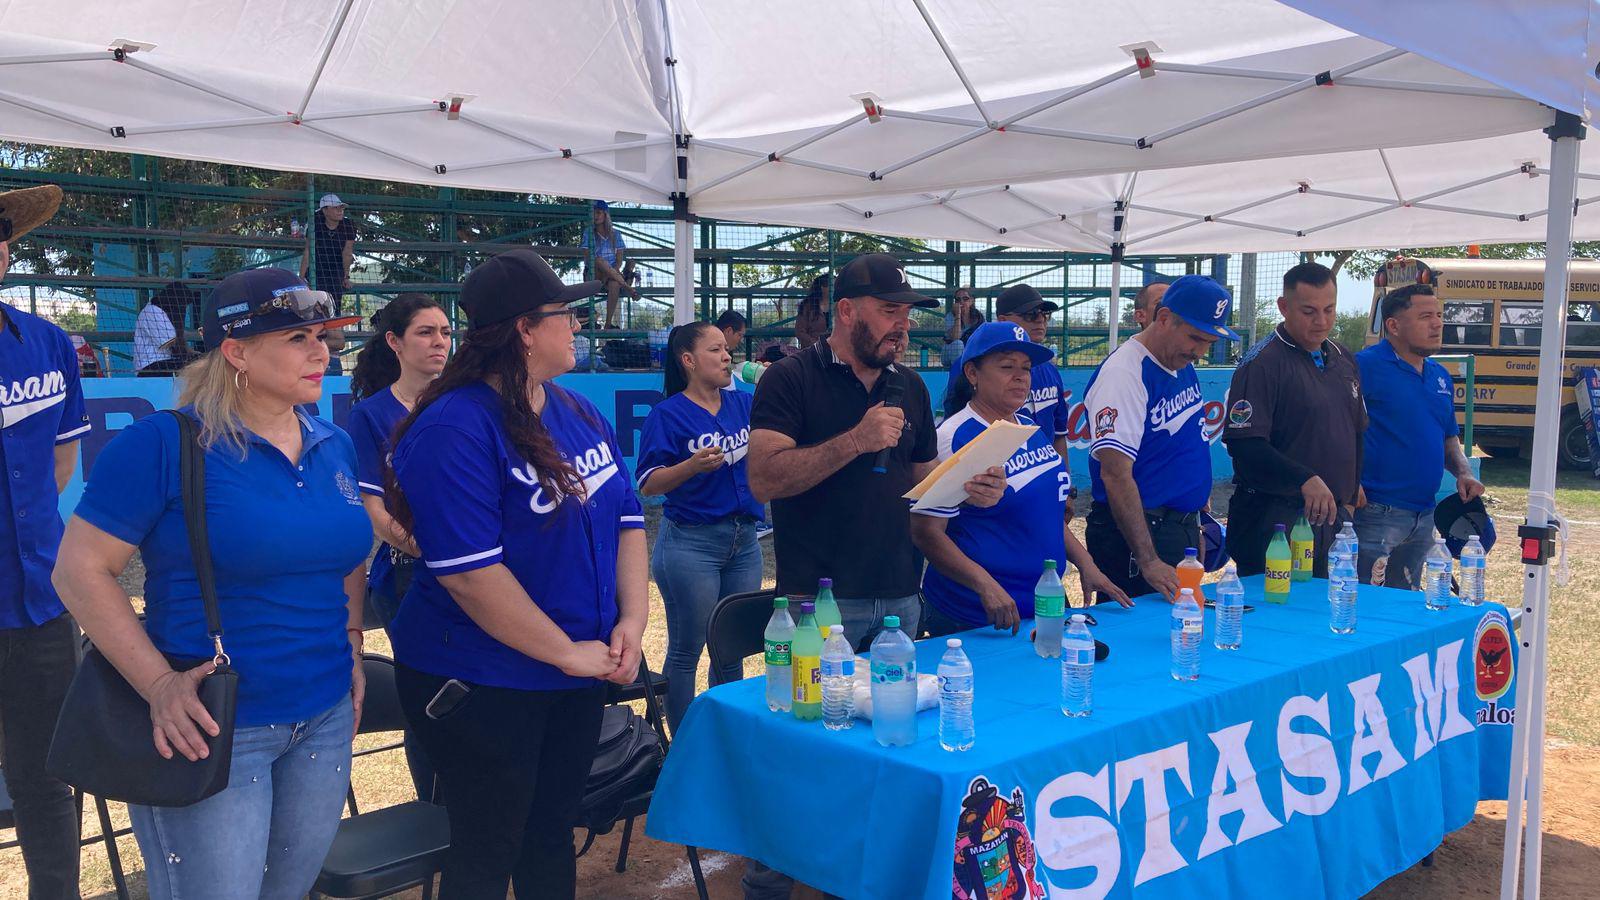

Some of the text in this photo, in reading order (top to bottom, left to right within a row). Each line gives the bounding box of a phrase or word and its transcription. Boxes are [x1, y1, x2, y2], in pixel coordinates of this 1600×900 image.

[1446, 279, 1485, 289] SINDICATO
[1487, 280, 1497, 289] DE
[1499, 281, 1544, 291] TRABAJADO
[1506, 360, 1536, 371] Grande
[1456, 387, 1497, 400] OARY
[687, 425, 751, 454] Stasa
[1003, 444, 1058, 474] uerrero
[511, 441, 614, 514] Ssam
[1057, 472, 1071, 501] 2
[885, 667, 902, 677] ciel
[1035, 638, 1476, 900] STASAM
[970, 831, 1009, 856] MAZATLAN
